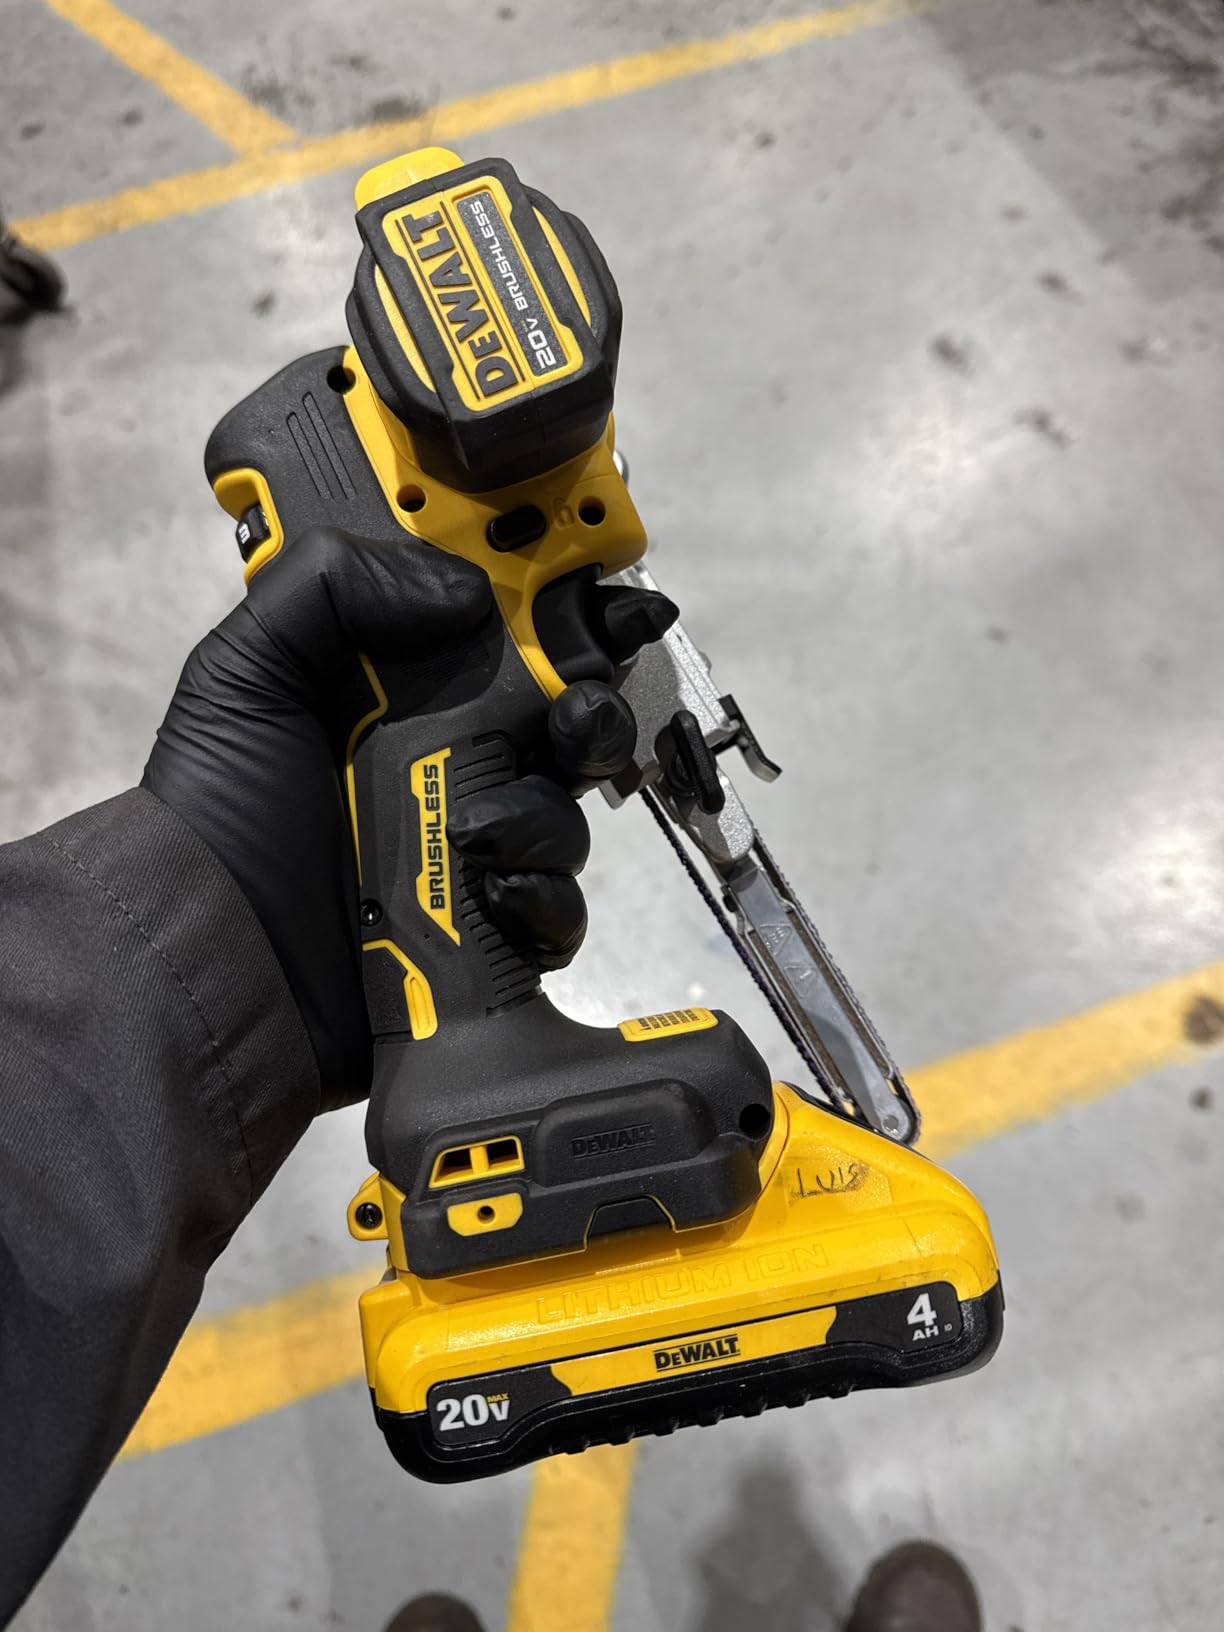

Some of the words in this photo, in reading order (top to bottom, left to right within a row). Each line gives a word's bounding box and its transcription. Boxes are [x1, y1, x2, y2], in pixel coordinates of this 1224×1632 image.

[470, 200, 529, 312] BRUSHLESS
[402, 210, 519, 398] DEWALT
[423, 763, 446, 910] BRUSHLESS
[571, 1126, 657, 1157] DEWALT
[536, 1261, 733, 1325] LITHIUM
[748, 1243, 831, 1283] ION
[906, 1292, 938, 1327] 4
[654, 1335, 740, 1370] DEWALT
[911, 1325, 940, 1341] AH
